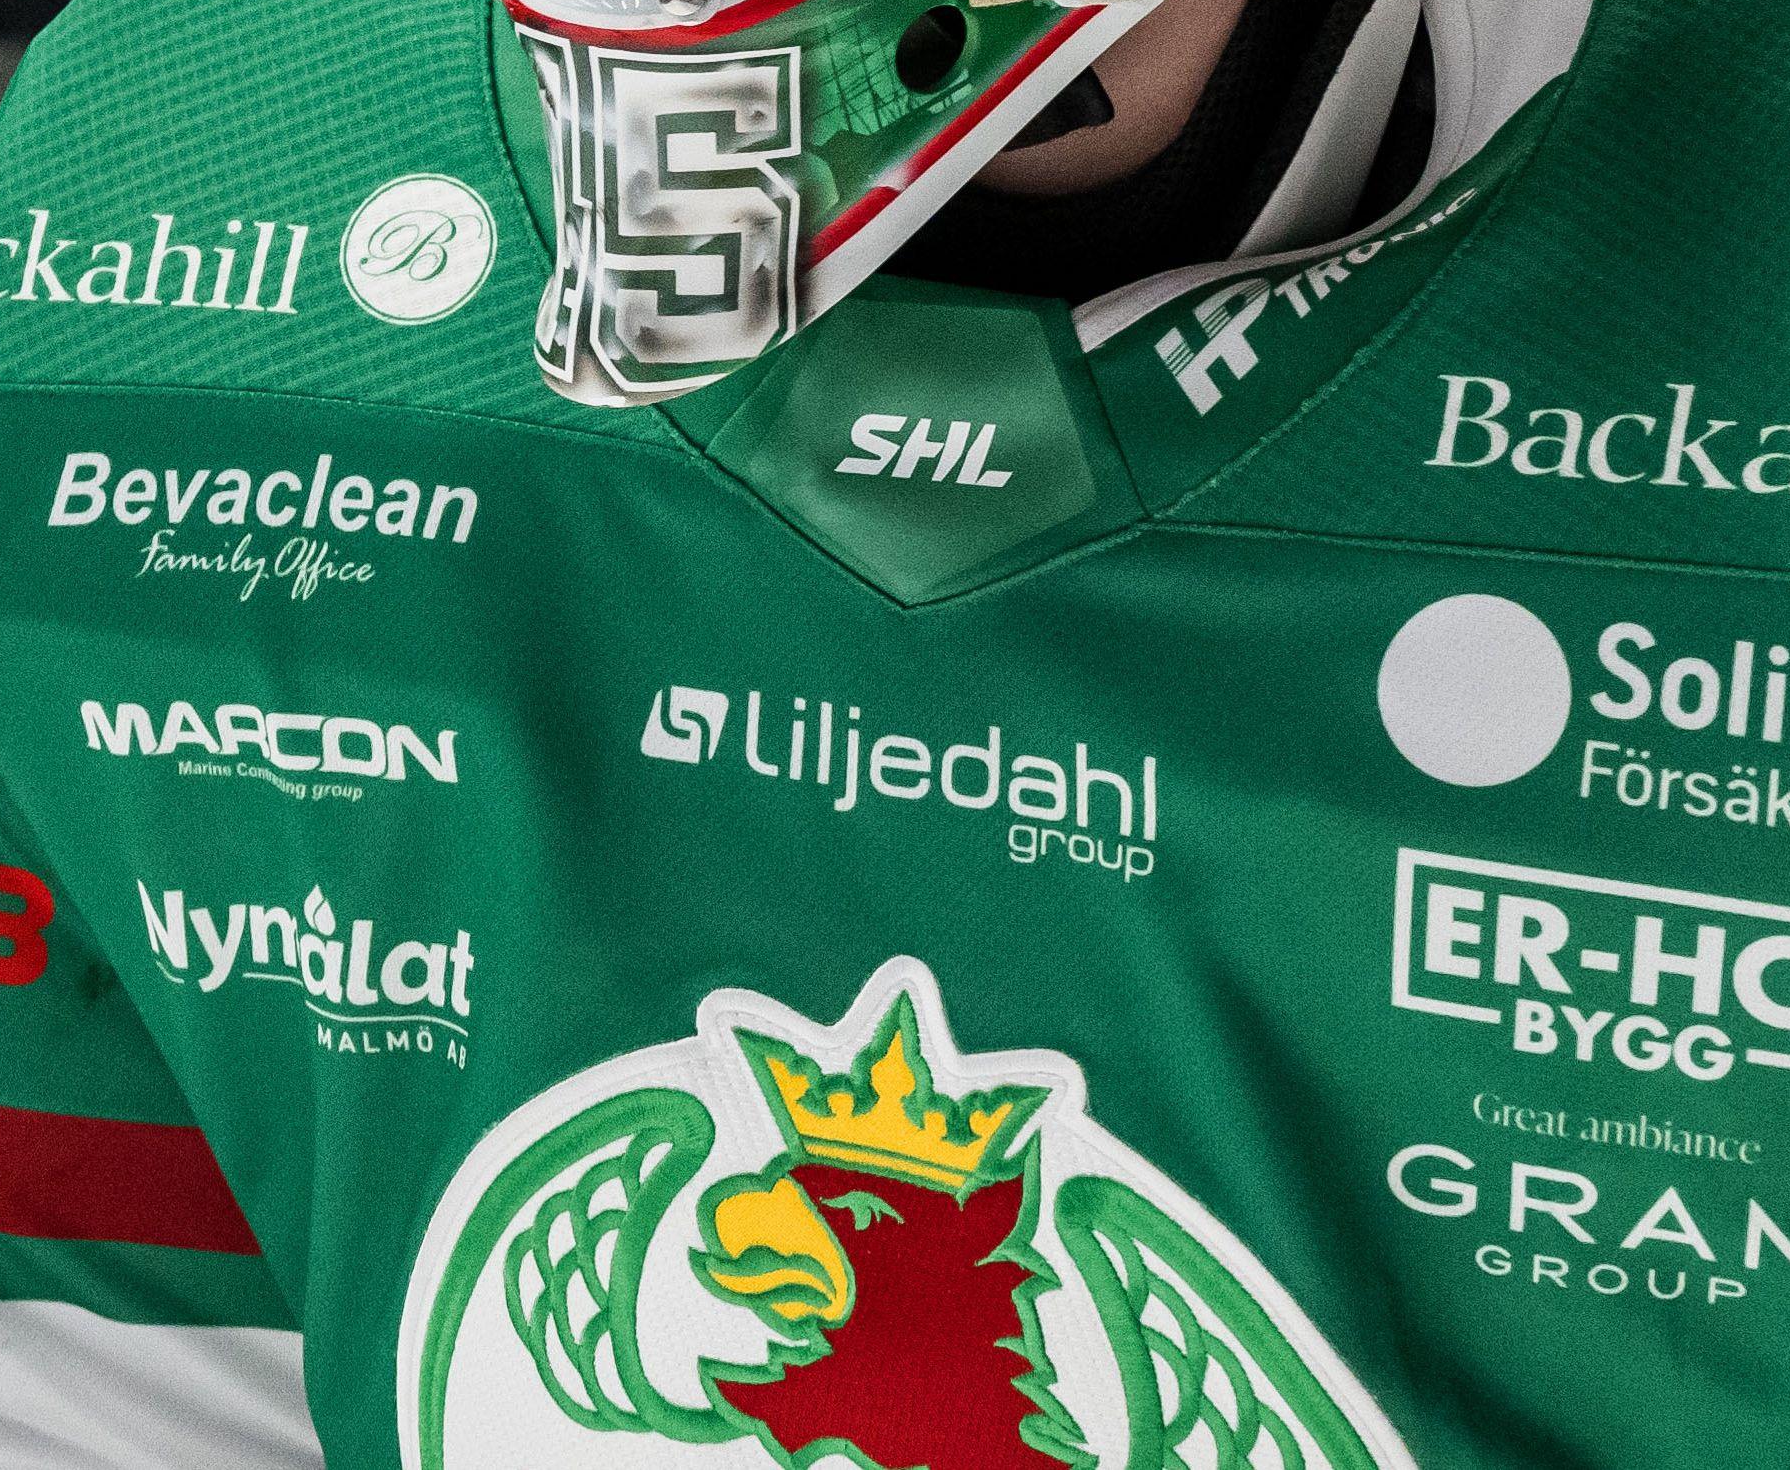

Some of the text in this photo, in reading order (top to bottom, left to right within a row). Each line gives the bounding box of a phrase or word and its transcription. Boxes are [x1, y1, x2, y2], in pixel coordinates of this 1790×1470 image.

[835, 413, 1013, 488] SHL
[47, 452, 478, 546] Bevaclean
[134, 528, 377, 602] Family Office
[80, 700, 459, 787] MARCON
[744, 689, 1157, 841] Liljedahl
[177, 761, 232, 777] Marine
[312, 785, 363, 802] group
[1004, 822, 1159, 885] group
[316, 1023, 467, 1070] MALMÖ AB
[1511, 996, 1736, 1082] BYGG
[1472, 1090, 1763, 1166] Great ambiance
[1472, 1242, 1750, 1305] GROUP
